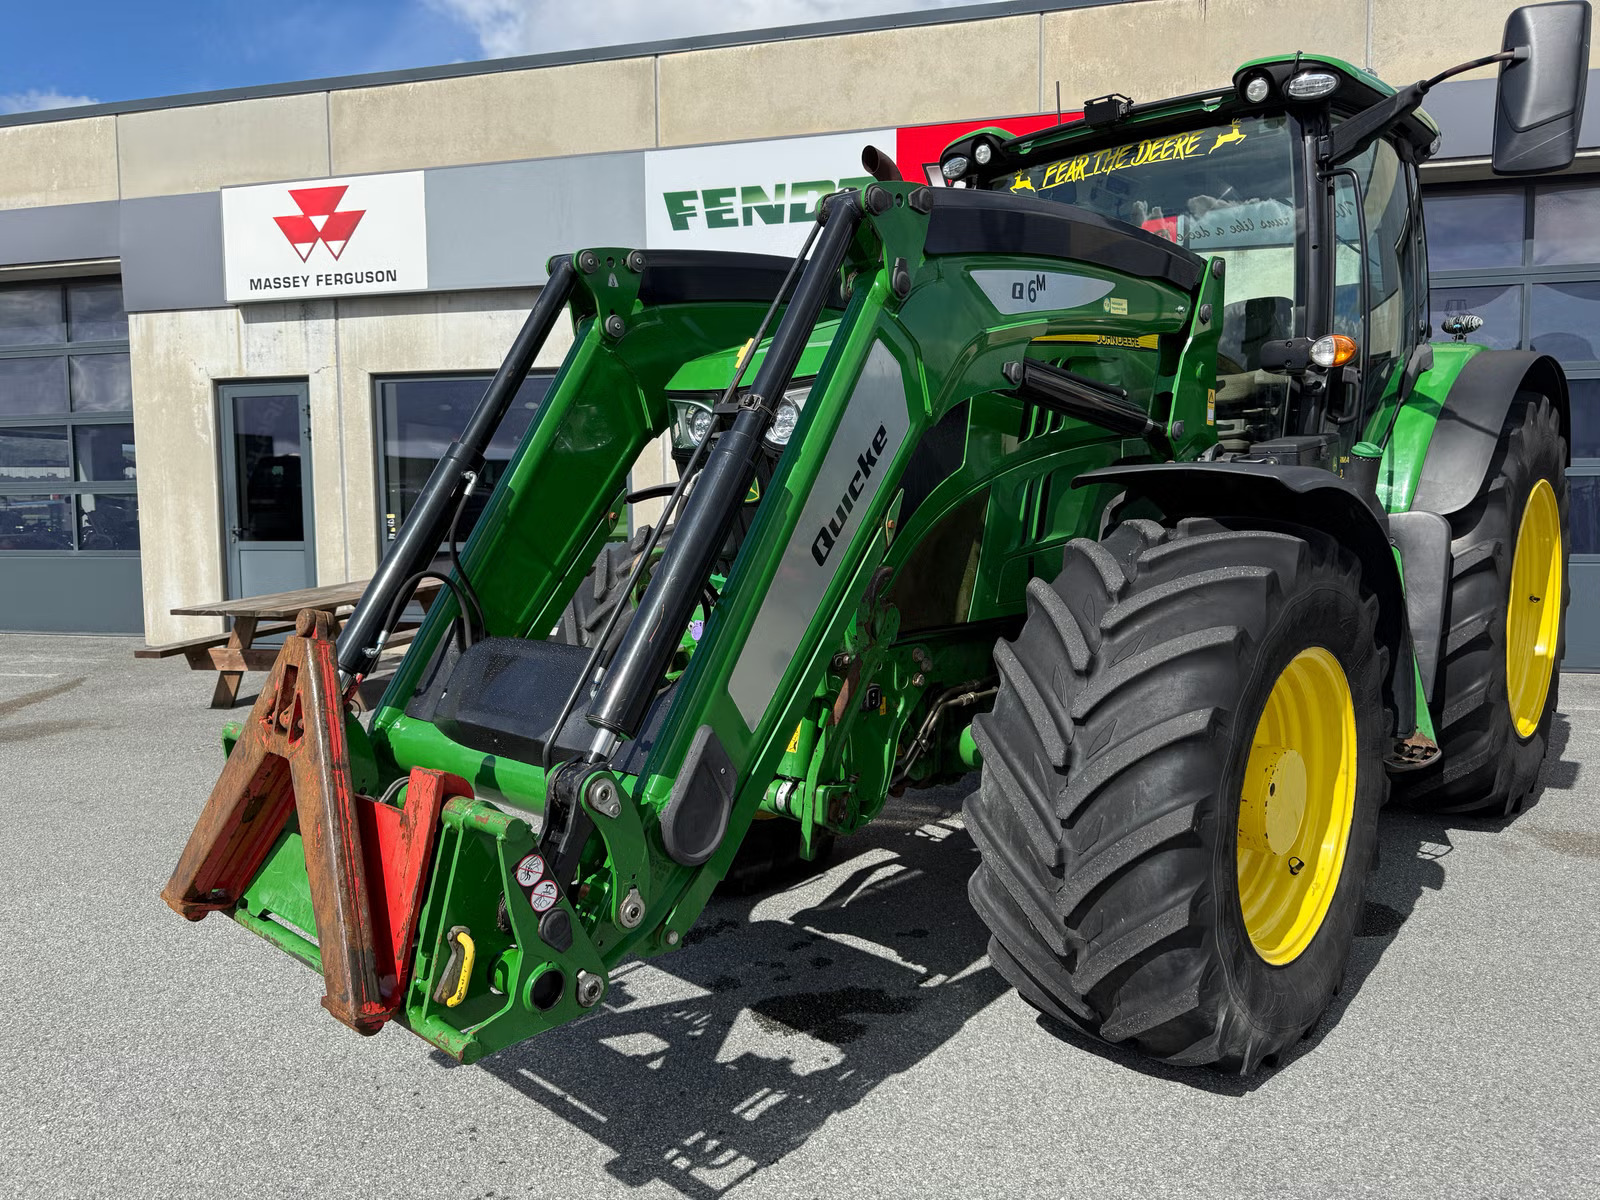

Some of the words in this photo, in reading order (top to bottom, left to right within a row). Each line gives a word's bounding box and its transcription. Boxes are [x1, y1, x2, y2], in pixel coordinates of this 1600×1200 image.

[1042, 152, 1089, 187] FEAR
[1092, 142, 1133, 175] THE
[1129, 130, 1206, 166] DEERE
[249, 275, 310, 291] MASSEY
[316, 269, 397, 287] FERGUSON
[811, 424, 888, 567] Quicke
